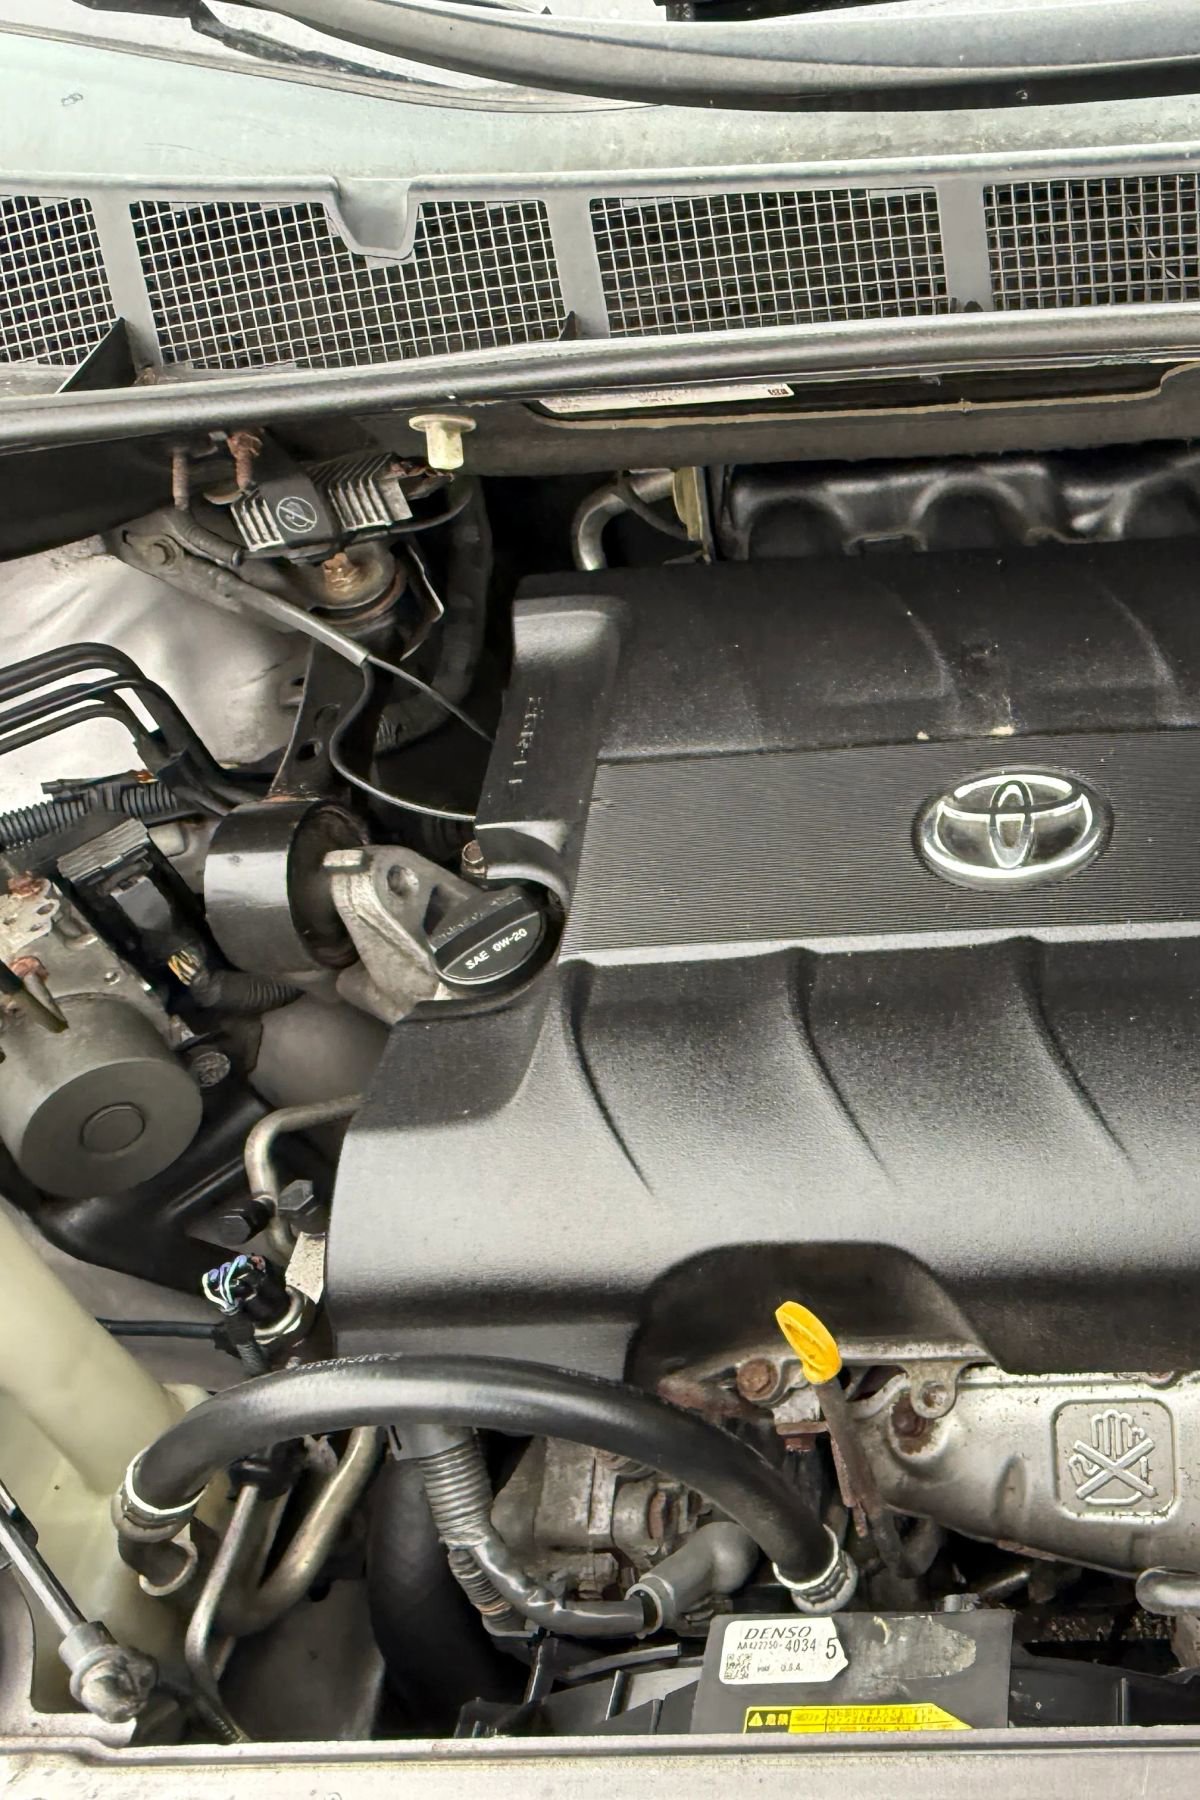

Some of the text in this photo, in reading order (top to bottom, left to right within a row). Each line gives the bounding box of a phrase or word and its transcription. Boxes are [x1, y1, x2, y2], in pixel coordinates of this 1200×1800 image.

[465, 928, 528, 969] SAE 0W-20
[744, 1626, 812, 1640] DENSO
[825, 1637, 838, 1660] 5
